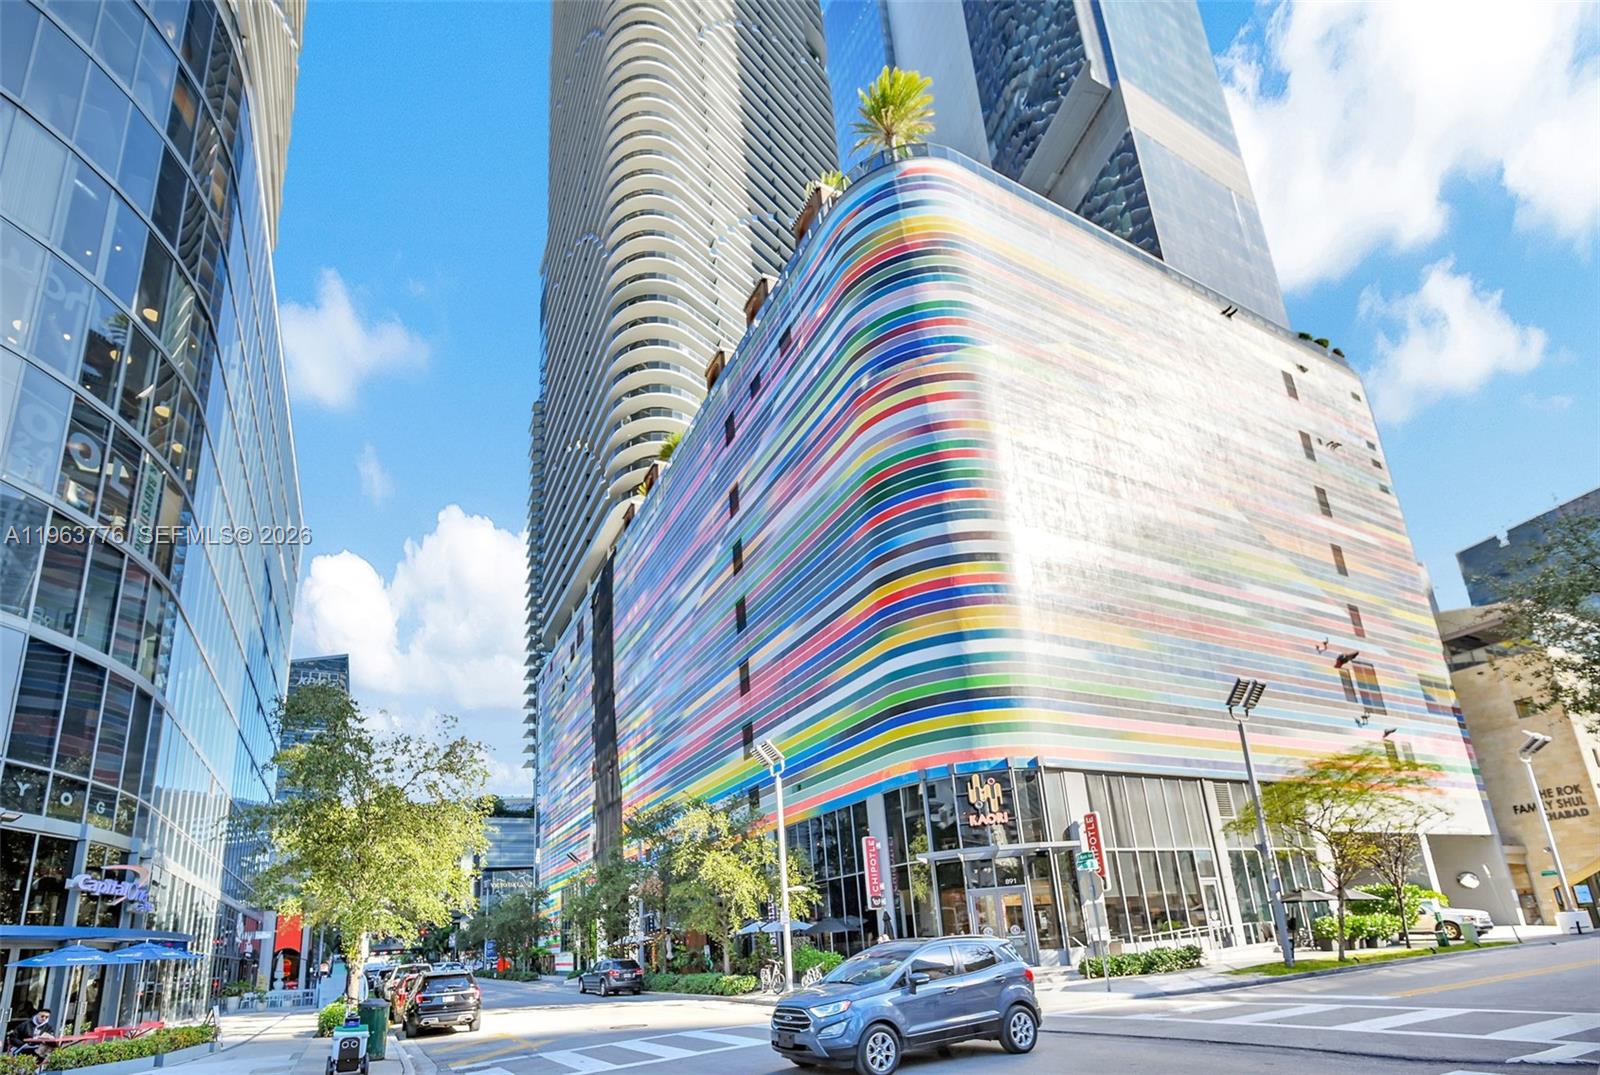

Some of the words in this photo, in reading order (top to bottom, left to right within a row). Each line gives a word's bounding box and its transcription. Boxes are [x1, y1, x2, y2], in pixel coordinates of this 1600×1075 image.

[1539, 788, 1555, 799] HE
[1556, 784, 1582, 797] ROK
[1512, 800, 1553, 815] FAMY
[1556, 796, 1587, 809] SHUL
[969, 812, 1008, 826] KAORI
[867, 839, 880, 893] CHIPOTLE
